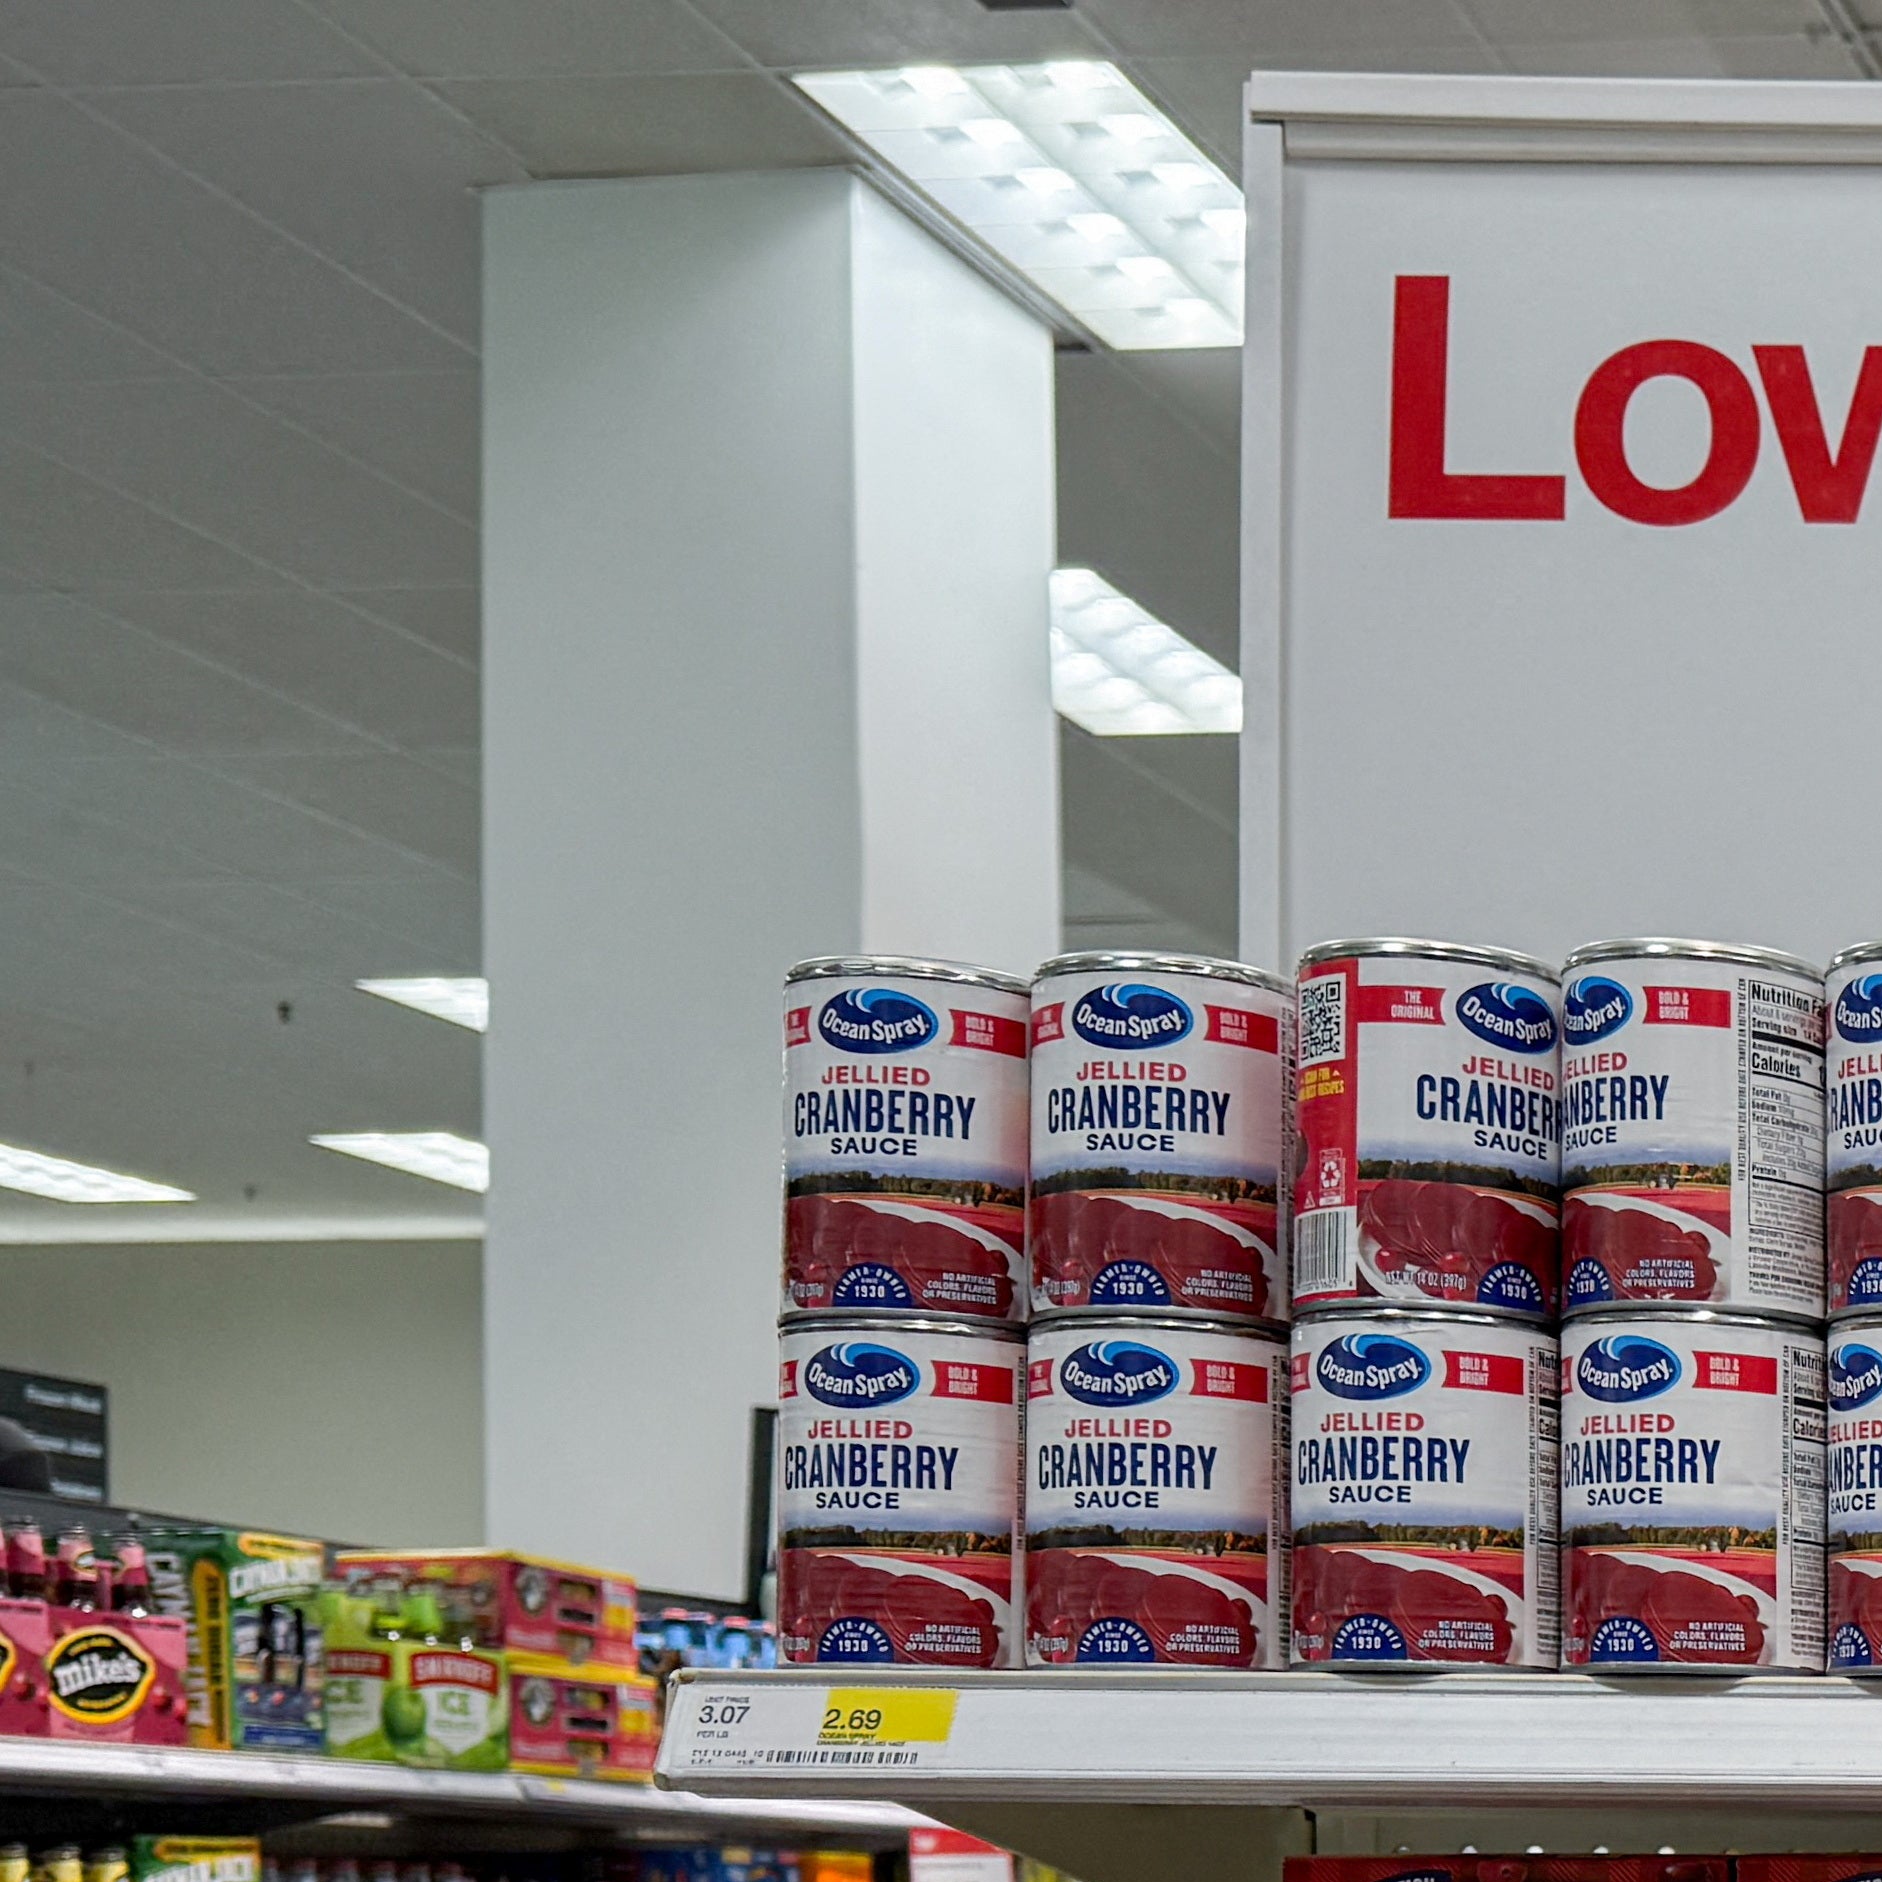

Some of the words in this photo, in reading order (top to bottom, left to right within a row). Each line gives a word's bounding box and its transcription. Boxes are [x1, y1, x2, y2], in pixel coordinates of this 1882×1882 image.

[1074, 1004, 1126, 1041] Ocean
[1076, 1061, 1187, 1082] JELLIED
[1048, 1088, 1230, 1136] CRANBERRY
[1086, 1133, 1174, 1152] SAUCE
[1320, 1413, 1424, 1433] JELLIED
[1298, 1437, 1469, 1486] CRANBERRY
[1328, 1485, 1412, 1504] SAUCE
[699, 1706, 750, 1724] 3.07
[822, 1709, 882, 1730] 2.69
